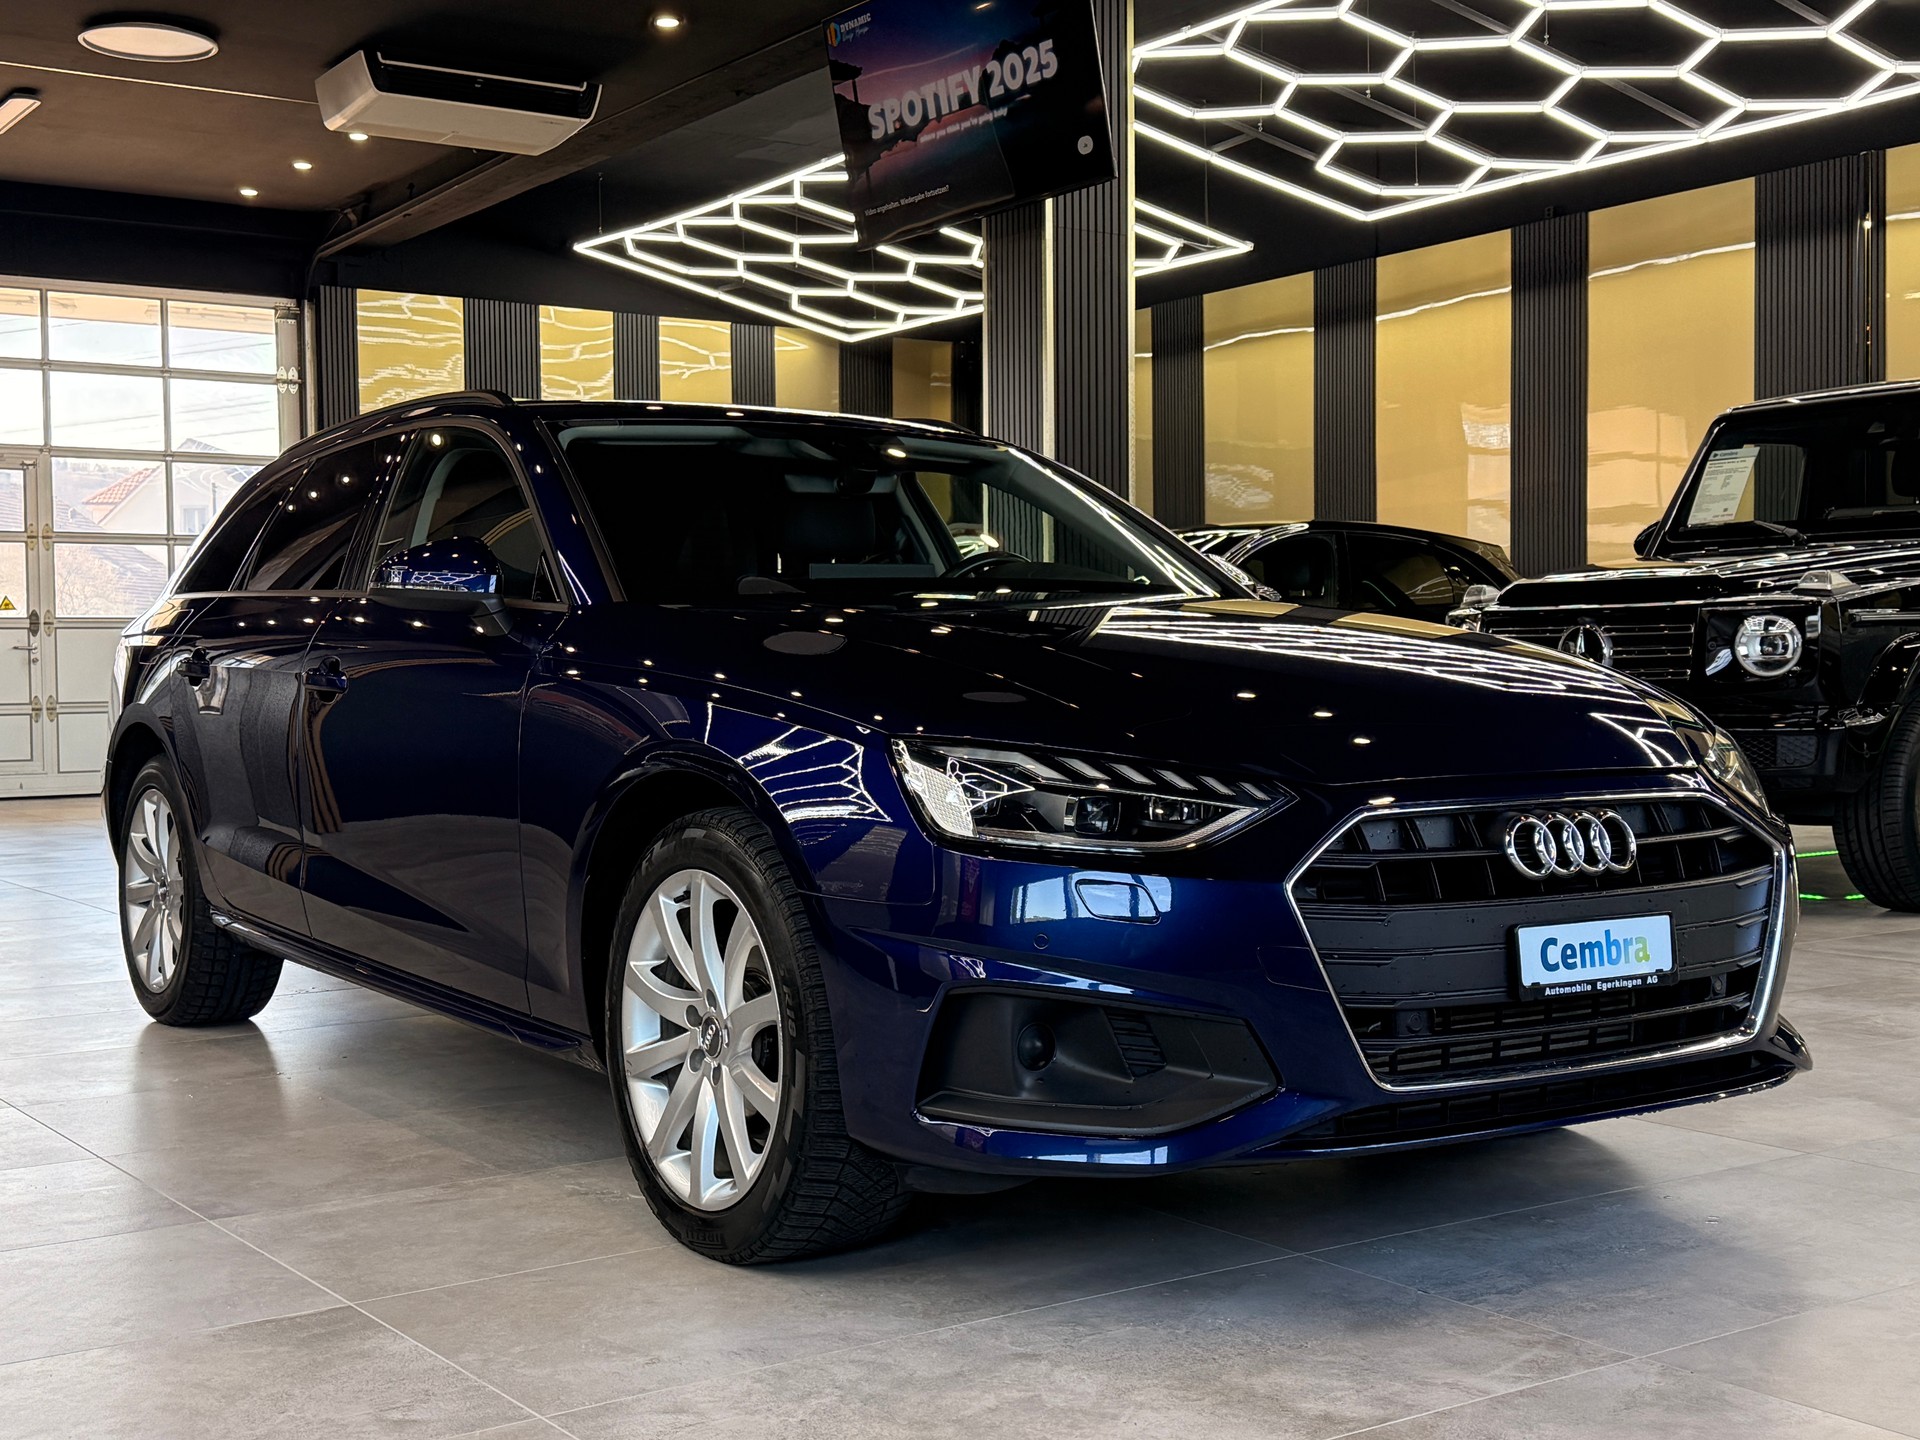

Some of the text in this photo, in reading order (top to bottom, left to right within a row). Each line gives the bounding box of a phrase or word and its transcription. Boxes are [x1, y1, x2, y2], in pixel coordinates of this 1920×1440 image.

[840, 13, 871, 32] DYNAMIC
[868, 38, 1058, 140] SPOTIFY 2025
[864, 208, 877, 216] Video
[900, 193, 925, 206] Wiedergabe
[925, 184, 949, 198] fortsetzen?
[1540, 929, 1651, 972] Cembra
[1544, 975, 1658, 996] Automobile Egerkingen AG
